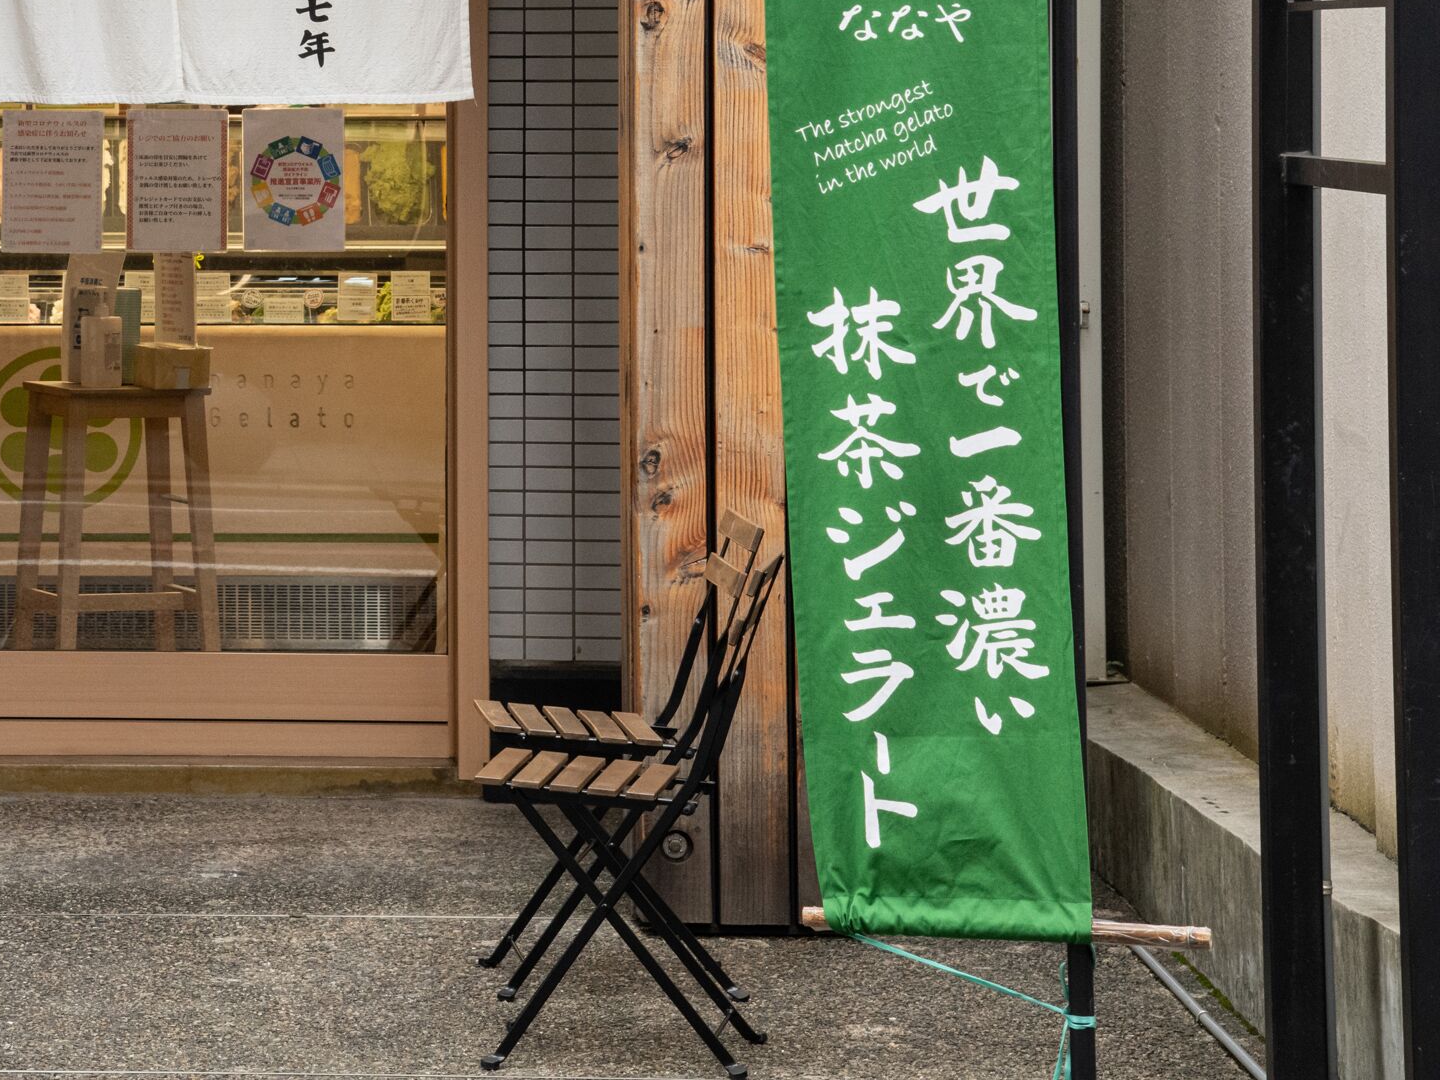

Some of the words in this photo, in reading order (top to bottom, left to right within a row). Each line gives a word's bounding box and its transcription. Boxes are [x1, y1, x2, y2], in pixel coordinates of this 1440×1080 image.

[838, 3, 972, 43] ななや
[795, 119, 835, 142] The
[838, 80, 933, 129] strongest
[813, 127, 888, 167] Matcha
[893, 103, 954, 143] gelato
[815, 173, 844, 194] in
[845, 162, 877, 183] the
[879, 134, 938, 170] world
[210, 407, 354, 428] Gelato
[912, 155, 1050, 736] 世界で一番濃い
[806, 286, 921, 849] 抹茶ジェラート
